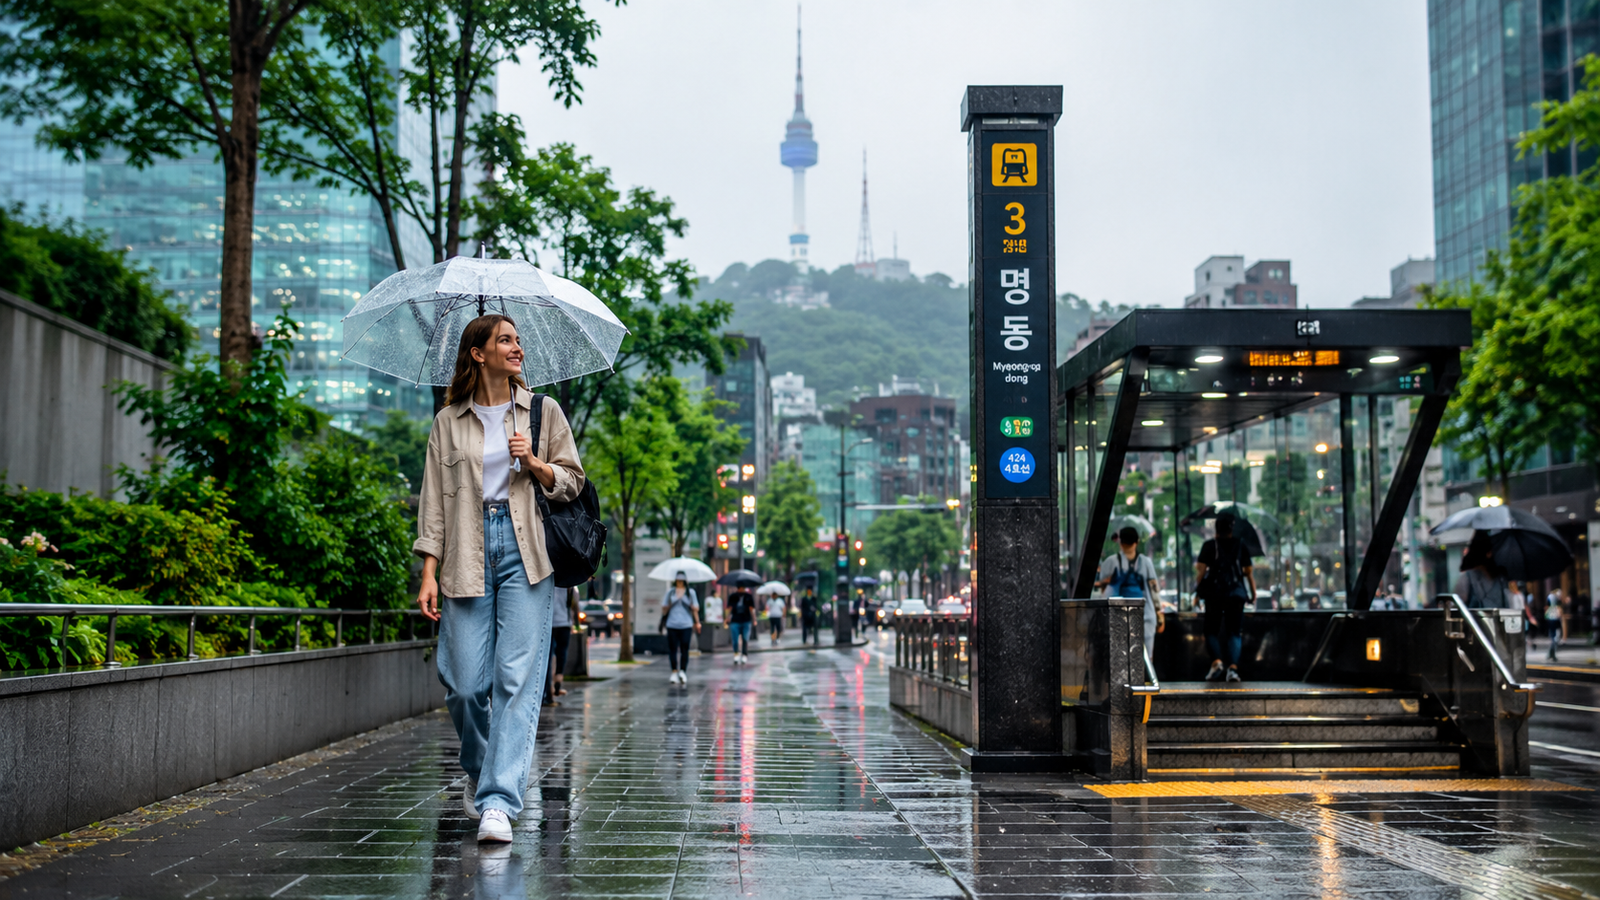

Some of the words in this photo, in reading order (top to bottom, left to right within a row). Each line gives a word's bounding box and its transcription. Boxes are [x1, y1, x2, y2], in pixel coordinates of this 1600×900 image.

[1004, 201, 1026, 235] 3
[1000, 268, 1032, 351] 명동
[1005, 373, 1028, 385] dong
[1008, 453, 1026, 462] 424
